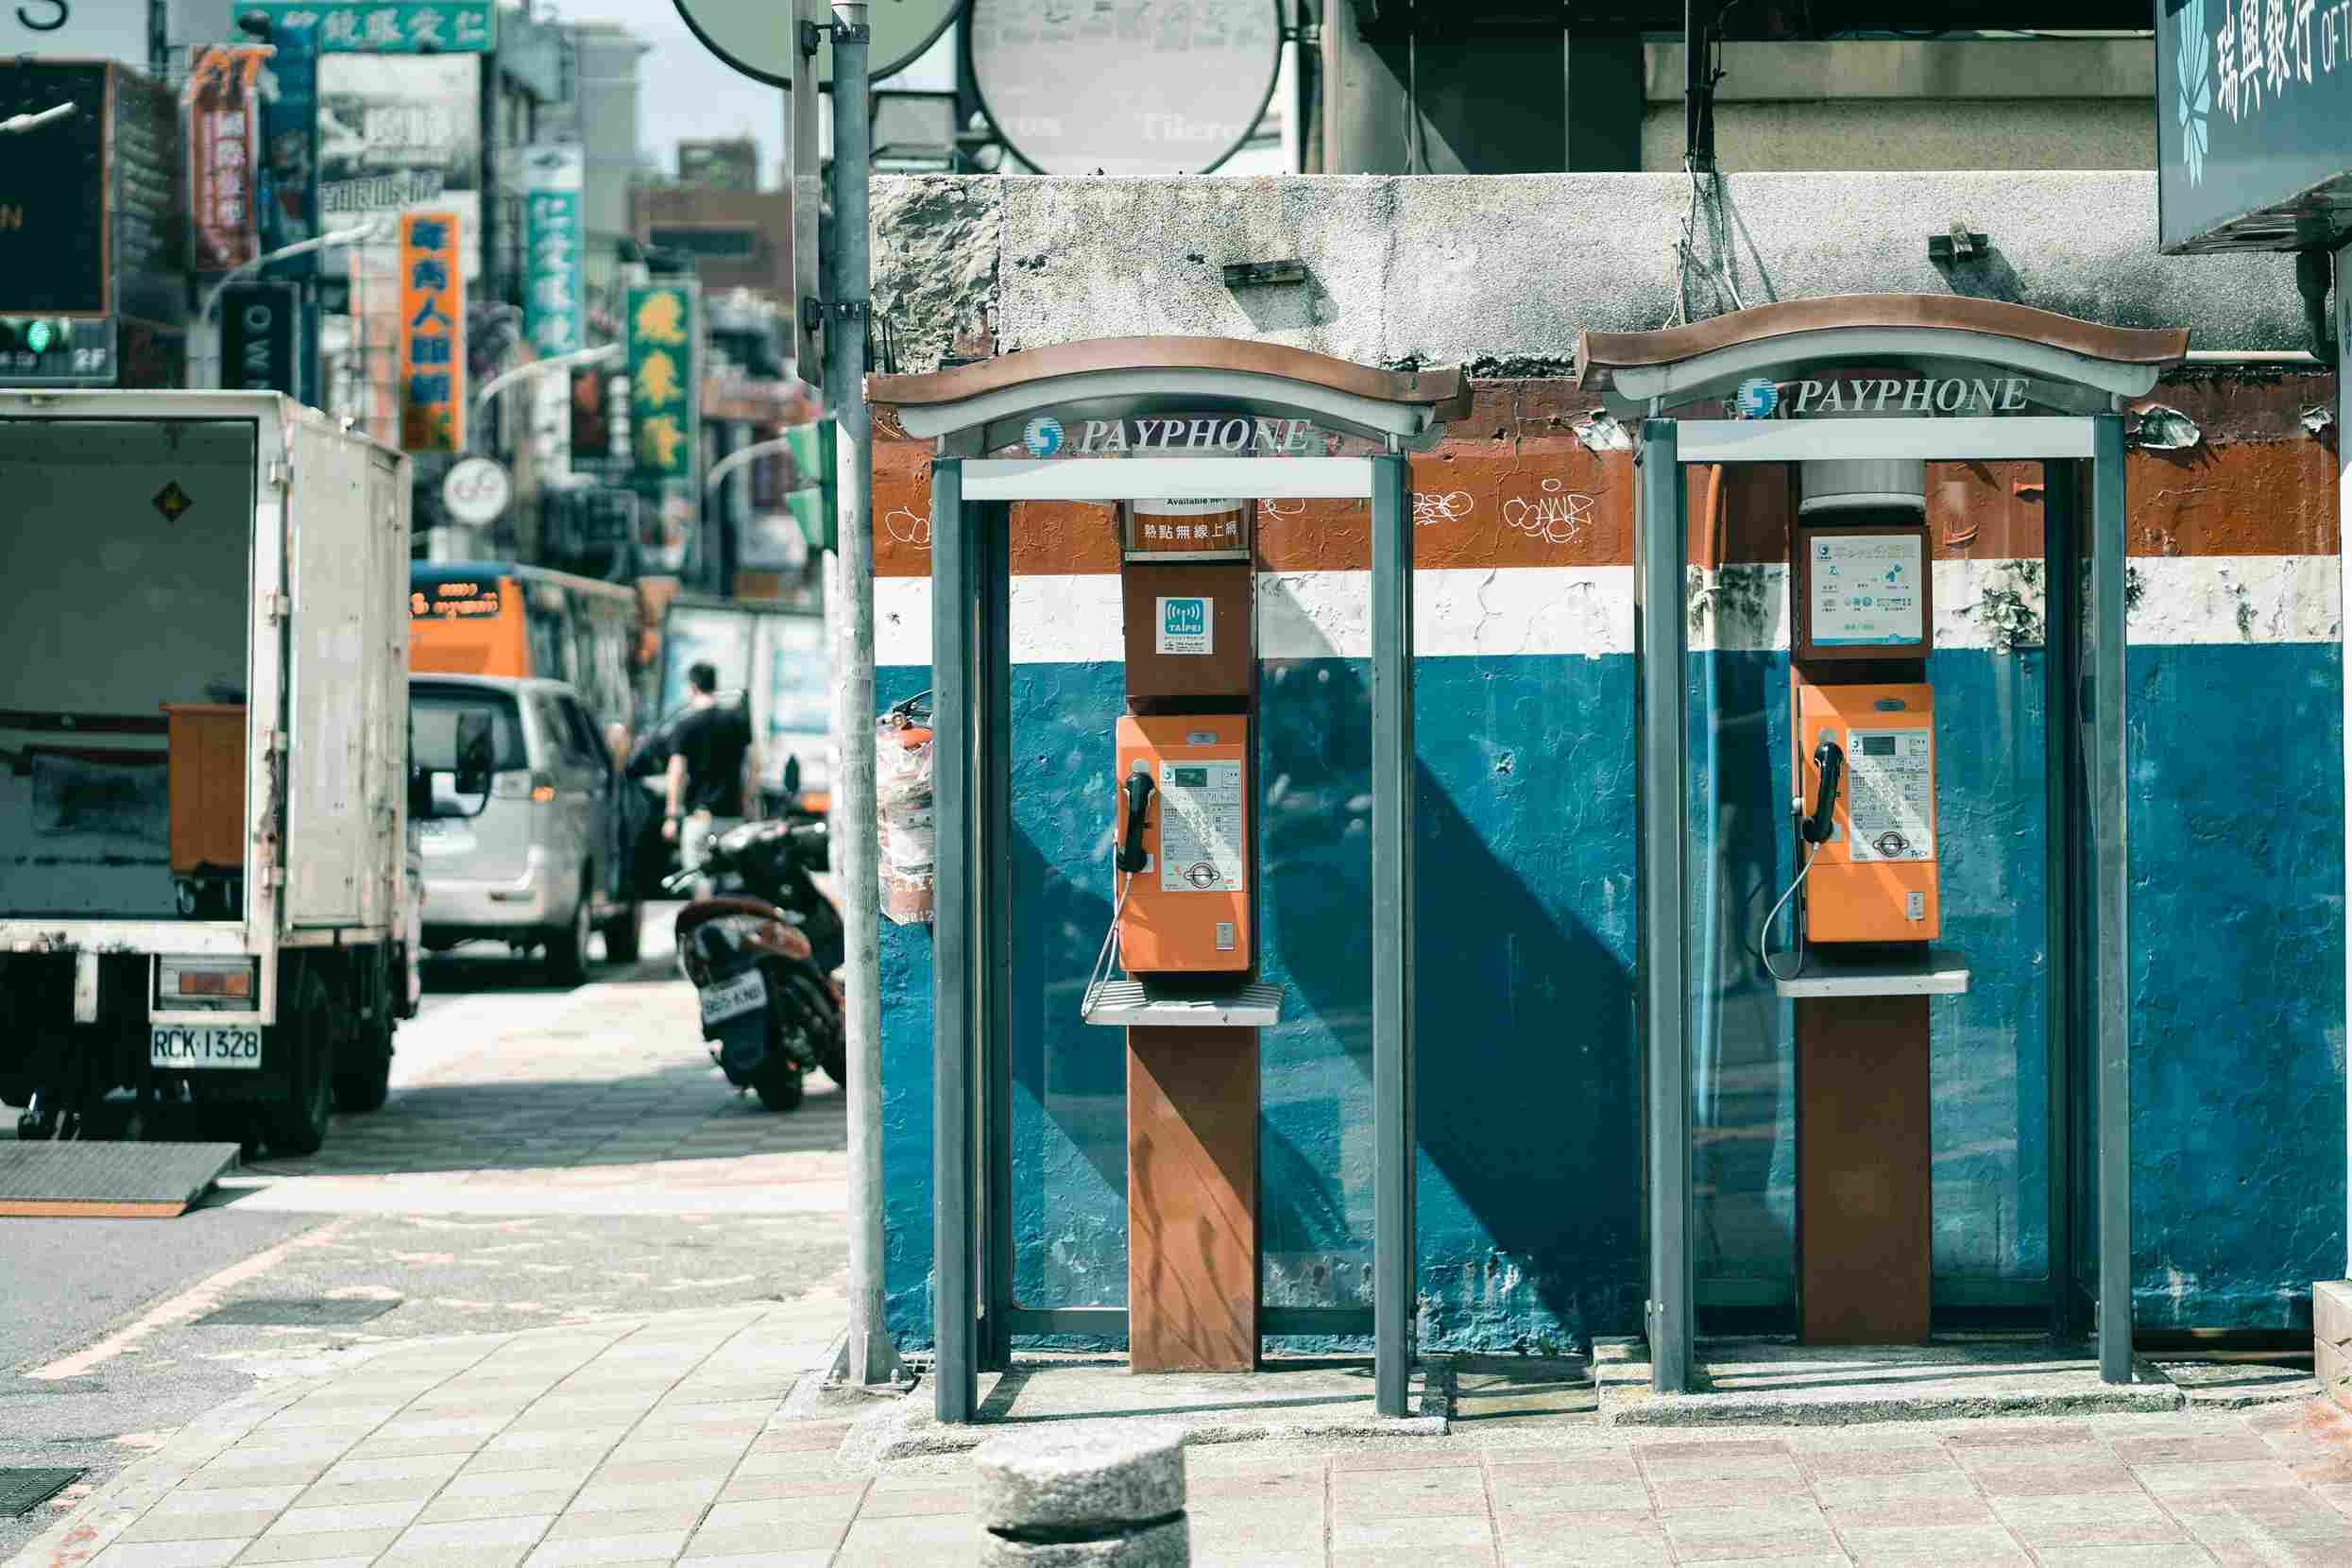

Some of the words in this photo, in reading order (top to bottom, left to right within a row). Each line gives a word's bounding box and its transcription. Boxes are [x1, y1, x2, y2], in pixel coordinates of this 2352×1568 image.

[1793, 377, 2030, 413] PAYPHONE
[1080, 418, 1312, 453] PAYPHONE
[1144, 520, 1239, 539] 熱點無線上網
[153, 1029, 260, 1059] RCK-1328
